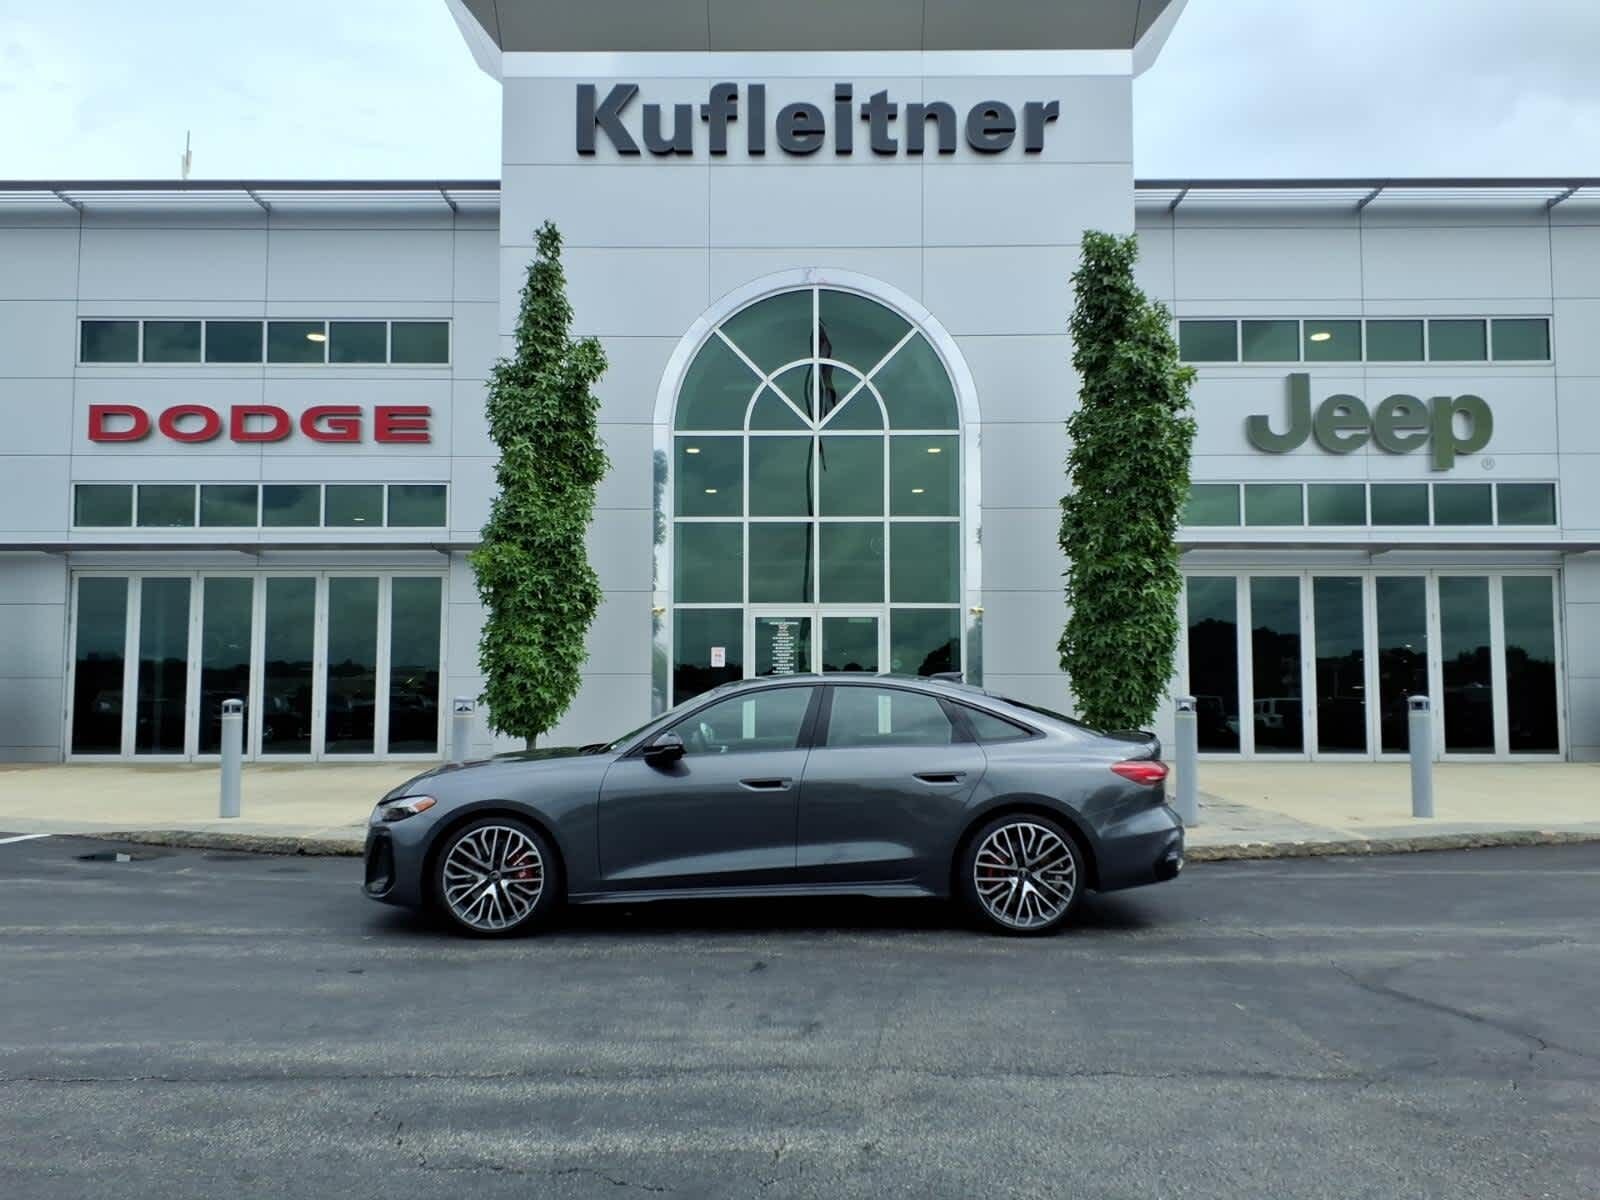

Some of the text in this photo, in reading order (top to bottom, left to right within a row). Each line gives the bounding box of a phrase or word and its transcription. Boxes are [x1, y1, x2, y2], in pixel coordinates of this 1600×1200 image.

[576, 82, 1060, 156] Kufleitner
[88, 404, 432, 443] DODGE
[1246, 372, 1494, 471] Jeep
